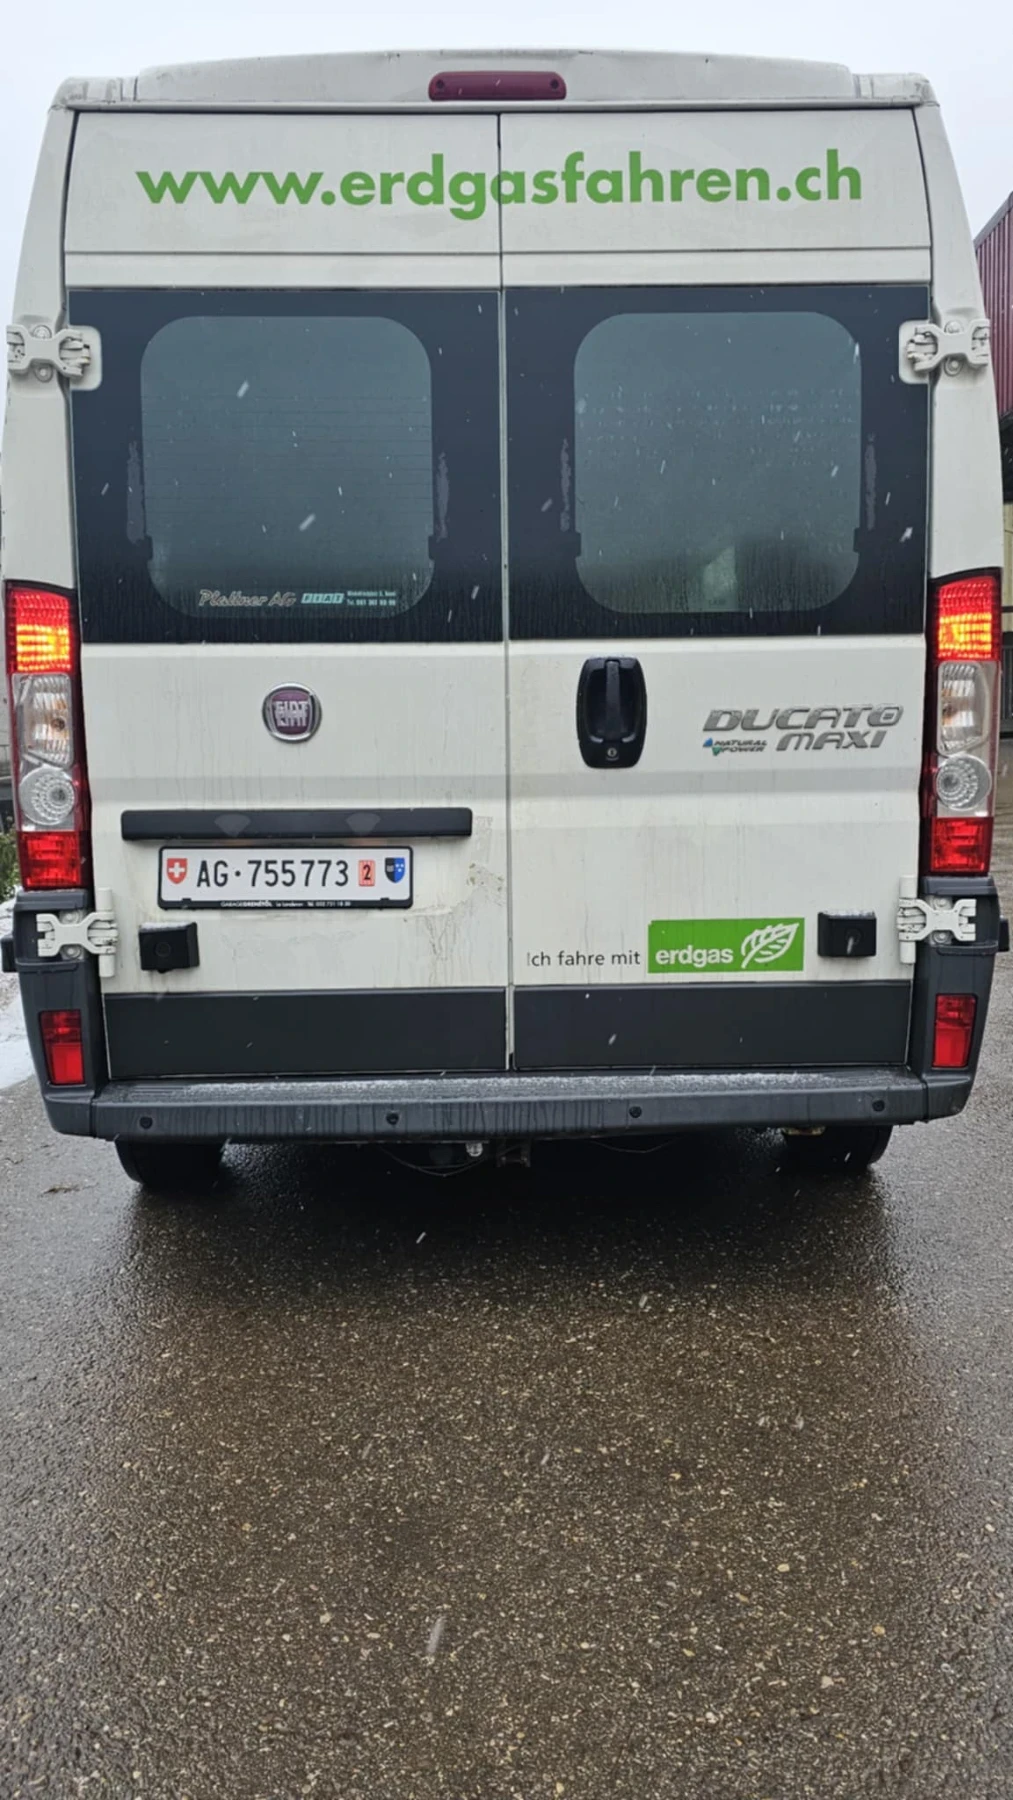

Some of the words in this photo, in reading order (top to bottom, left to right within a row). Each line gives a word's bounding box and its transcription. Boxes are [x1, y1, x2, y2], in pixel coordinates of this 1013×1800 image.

[136, 149, 862, 221] www.erdgasfahren.ch
[268, 591, 297, 607] AG
[703, 706, 903, 732] DUCATO
[776, 731, 887, 751] MAXI
[527, 951, 550, 966] Ich
[558, 951, 605, 966] fahre
[611, 950, 640, 965] mit
[655, 945, 733, 968] erdgas
